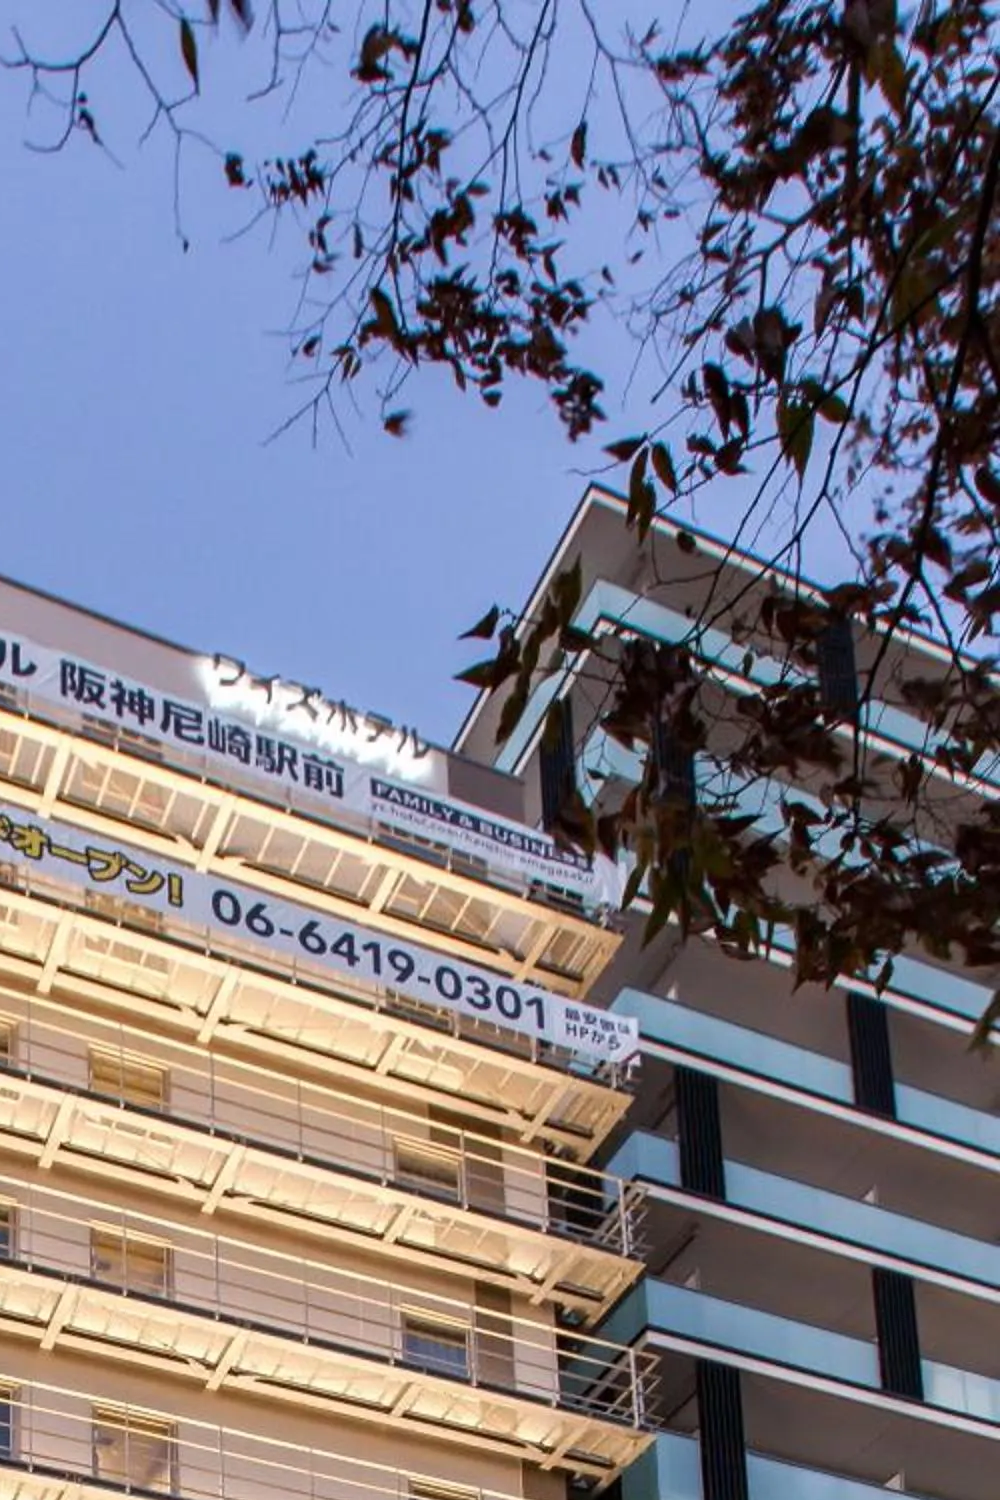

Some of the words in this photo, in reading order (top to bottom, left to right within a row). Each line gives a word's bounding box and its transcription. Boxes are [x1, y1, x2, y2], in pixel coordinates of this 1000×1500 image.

[58, 656, 345, 798] 阪神尼崎駅前
[376, 783, 454, 823] FAMILY
[211, 889, 546, 1030] 06-6419-0301
